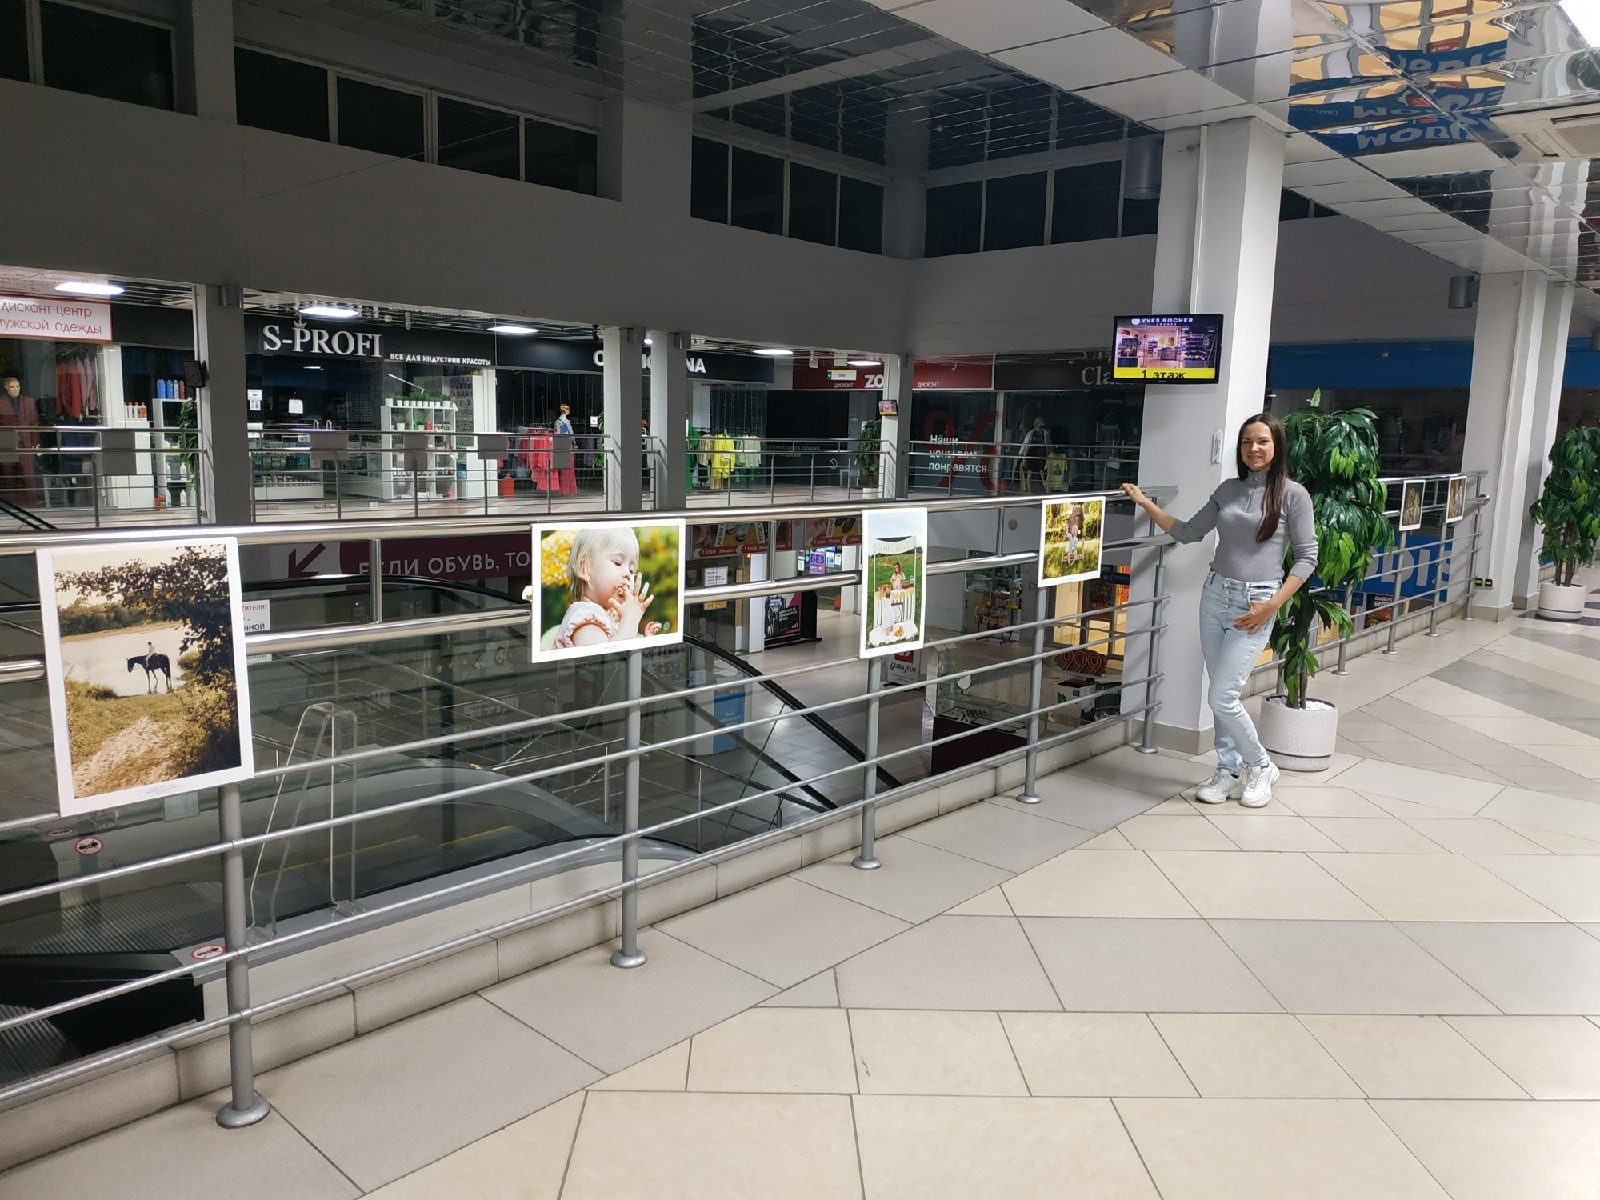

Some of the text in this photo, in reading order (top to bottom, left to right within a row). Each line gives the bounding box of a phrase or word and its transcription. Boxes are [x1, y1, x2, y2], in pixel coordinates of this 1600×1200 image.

[56, 306, 92, 319] центр
[55, 322, 102, 335] одежды
[262, 324, 383, 358] S-PROFI
[405, 354, 421, 362] ДЛЯ
[461, 357, 491, 366] КРАСОТЫ
[1142, 370, 1147, 378] 1
[359, 559, 419, 576] ЕЛИ
[428, 554, 500, 575] ОБУВЬ,
